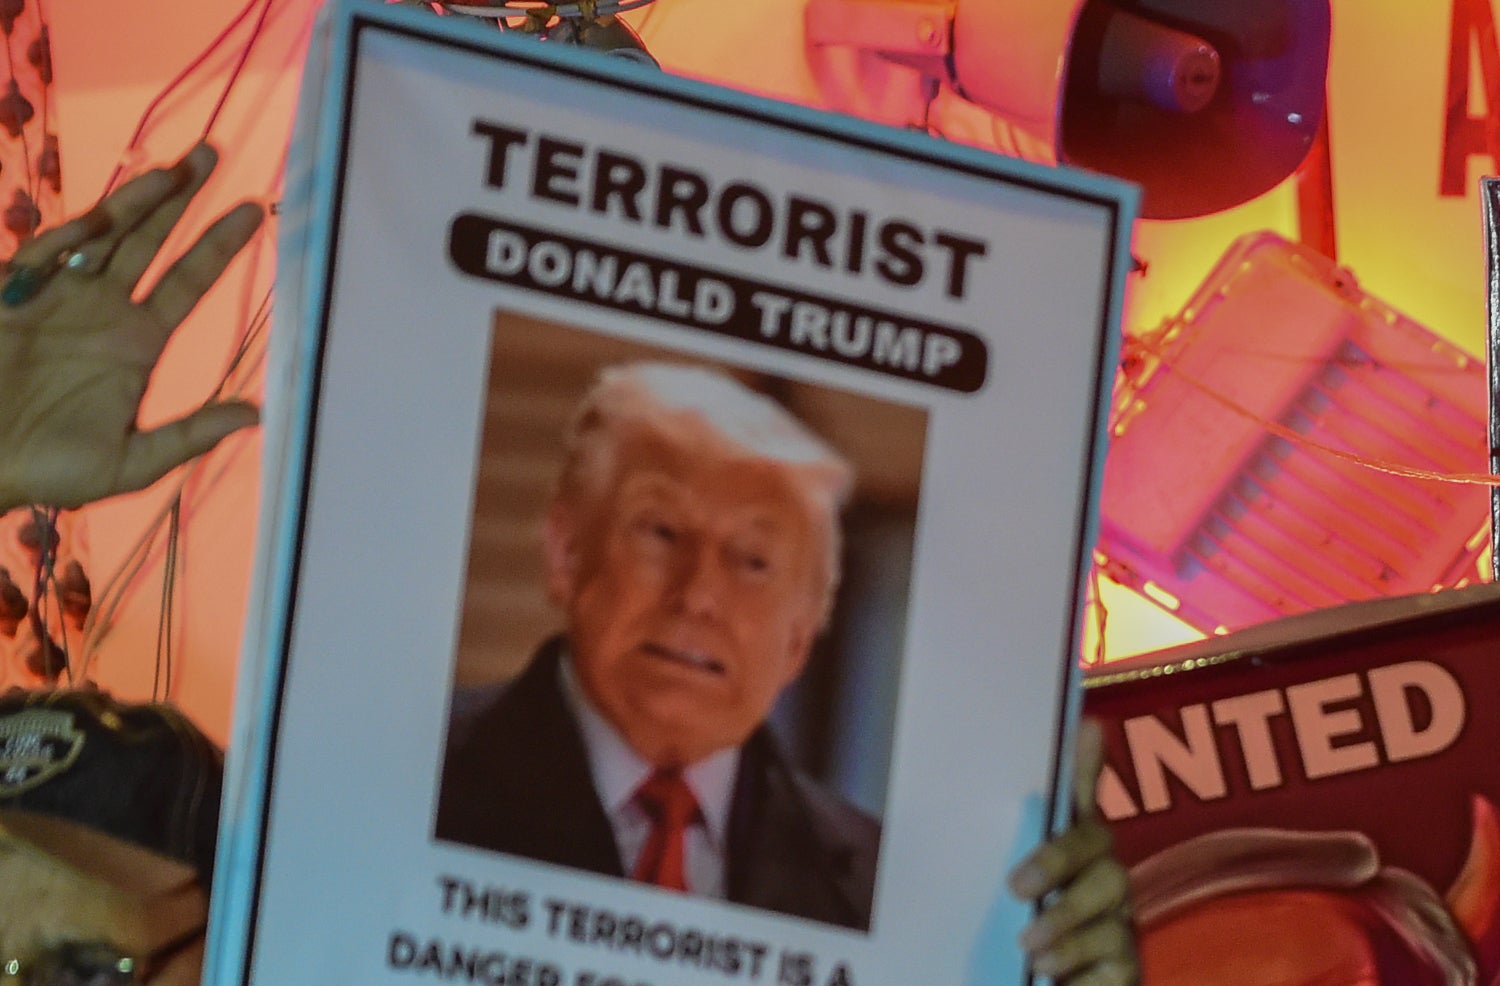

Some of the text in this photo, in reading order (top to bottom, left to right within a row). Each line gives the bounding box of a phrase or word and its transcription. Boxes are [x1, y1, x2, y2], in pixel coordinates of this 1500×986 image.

[471, 119, 987, 300] TERRORIST
[485, 230, 962, 377] DONALD TRUMP
[438, 876, 530, 931] THIS
[544, 900, 769, 979] TERRORIST
